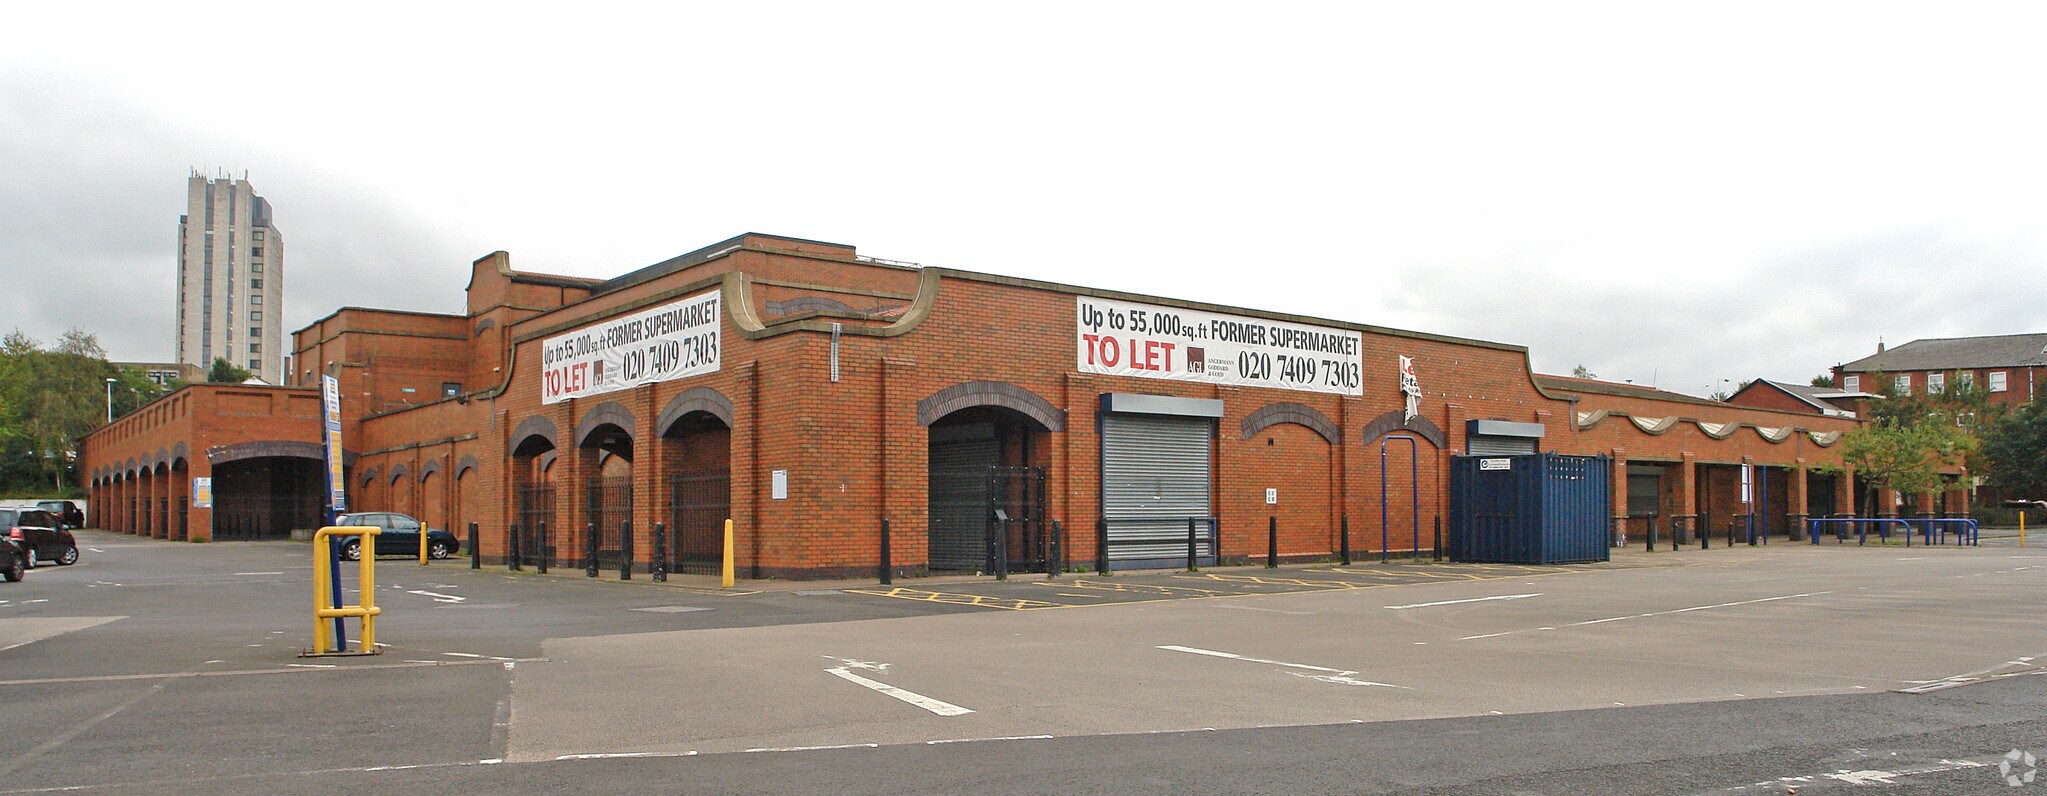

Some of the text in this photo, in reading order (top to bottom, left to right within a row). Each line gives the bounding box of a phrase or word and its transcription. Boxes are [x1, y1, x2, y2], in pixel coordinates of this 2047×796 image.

[544, 346, 554, 369] Up
[556, 343, 564, 363] to
[607, 321, 643, 349] FORMER
[644, 299, 717, 340] SUPERMARKET
[1082, 303, 1104, 333] Up
[1108, 308, 1125, 330] to
[1129, 310, 1181, 336] 55,000
[1211, 319, 1267, 346] FORMER
[1269, 326, 1359, 356] SUPERMARKET
[623, 348, 645, 381] 020
[649, 340, 680, 376] 7409
[683, 331, 717, 369] 7303
[1082, 334, 1176, 372] TO LET
[1238, 350, 1360, 389] 020 7409 7303
[545, 369, 560, 398] TO
[564, 362, 588, 393] LET
